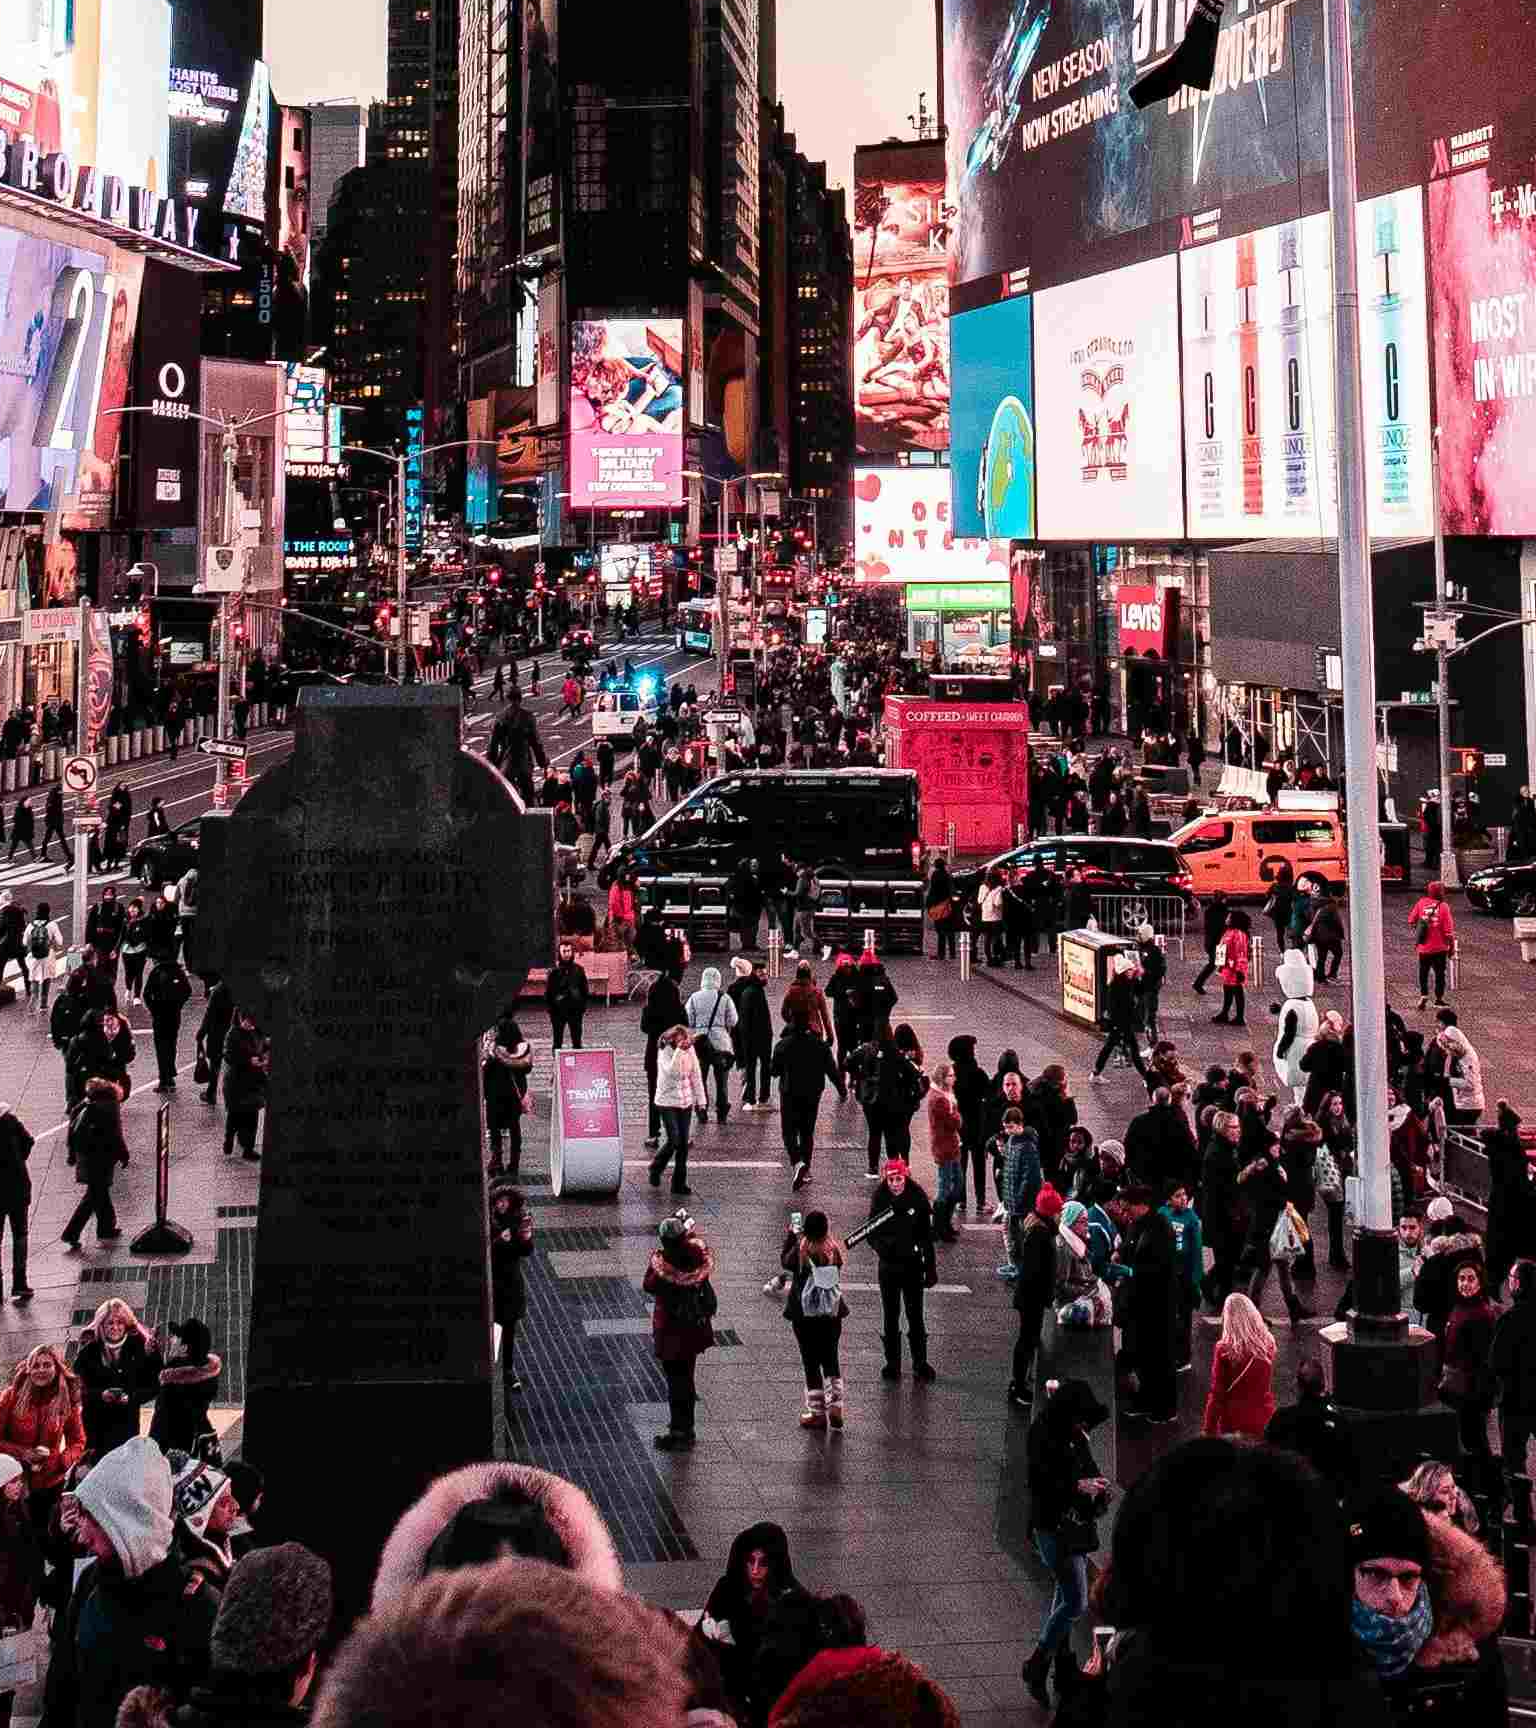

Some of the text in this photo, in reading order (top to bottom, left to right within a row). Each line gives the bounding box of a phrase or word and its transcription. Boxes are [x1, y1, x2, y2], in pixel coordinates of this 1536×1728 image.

[1031, 35, 1115, 102] NEW SEASON
[1022, 85, 1119, 152] NOW STREAMING
[1470, 292, 1527, 344] MOST
[1473, 357, 1497, 402] IN
[906, 710, 961, 722] COFFEED
